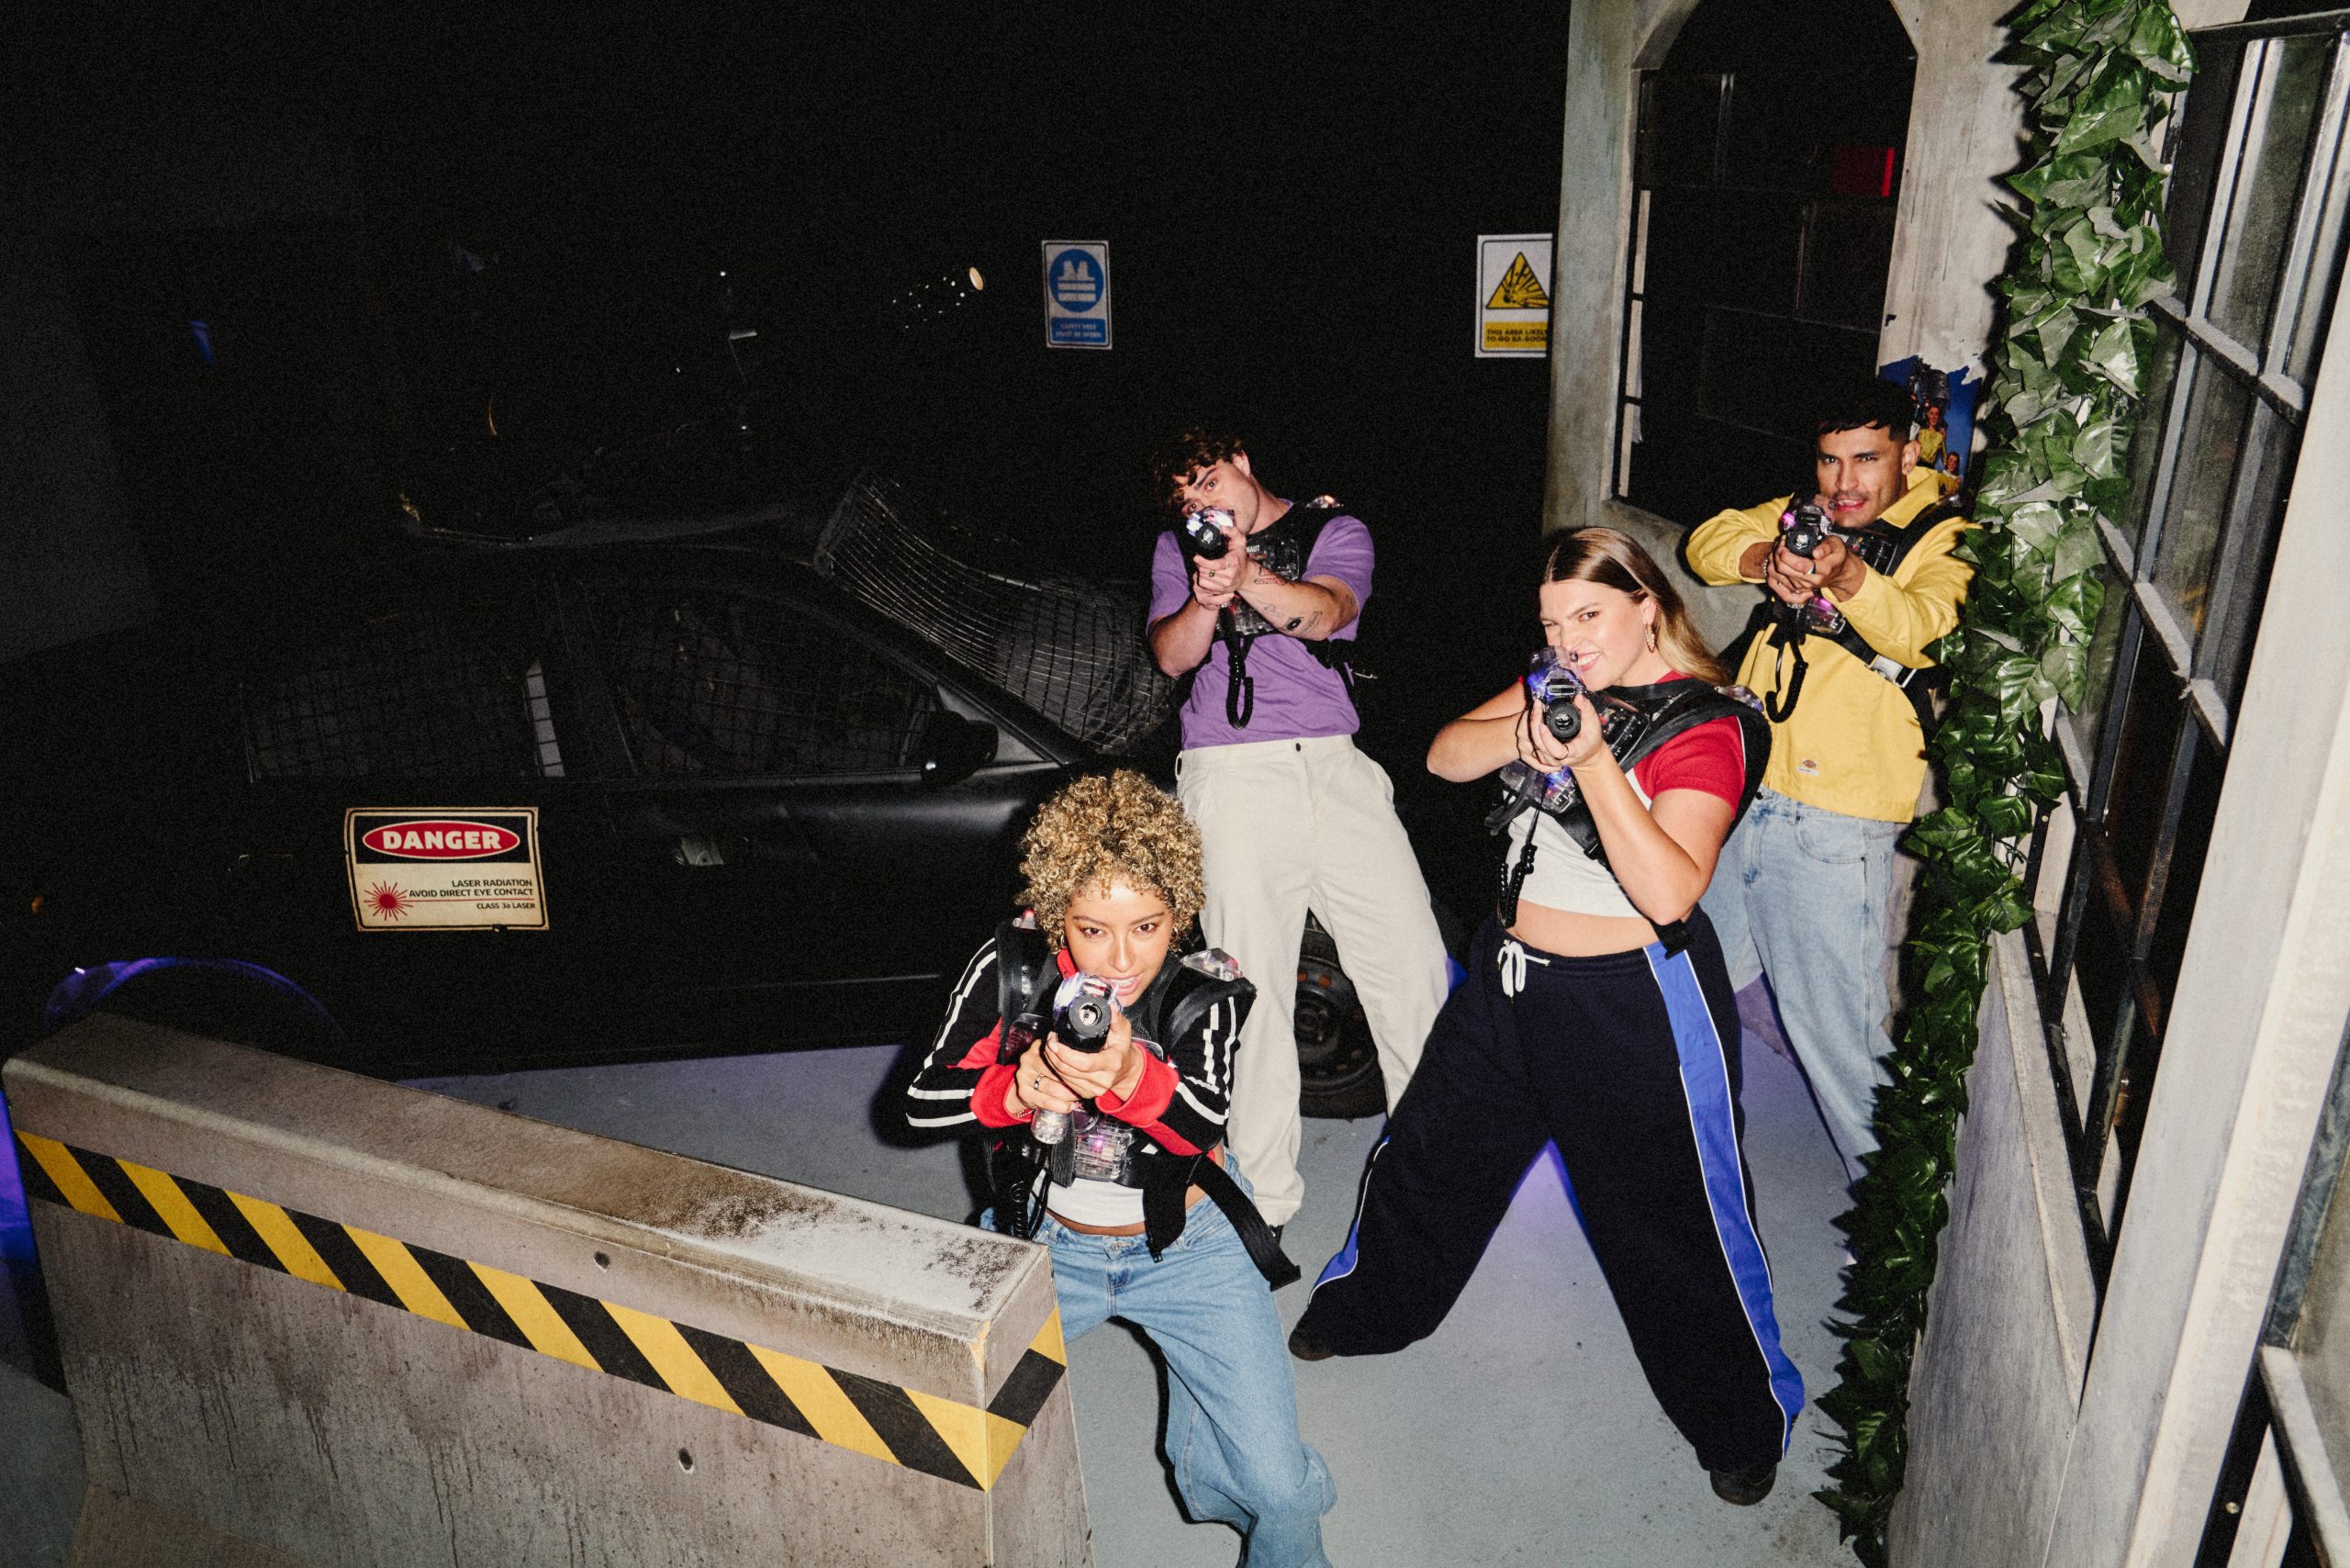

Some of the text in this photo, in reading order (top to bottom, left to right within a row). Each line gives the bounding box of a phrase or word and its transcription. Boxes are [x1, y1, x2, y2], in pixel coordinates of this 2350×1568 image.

[382, 830, 502, 850] DANGER
[452, 879, 532, 888] LASER RADIATION
[408, 888, 533, 898] AVOID DIRECT EYE CONTACT
